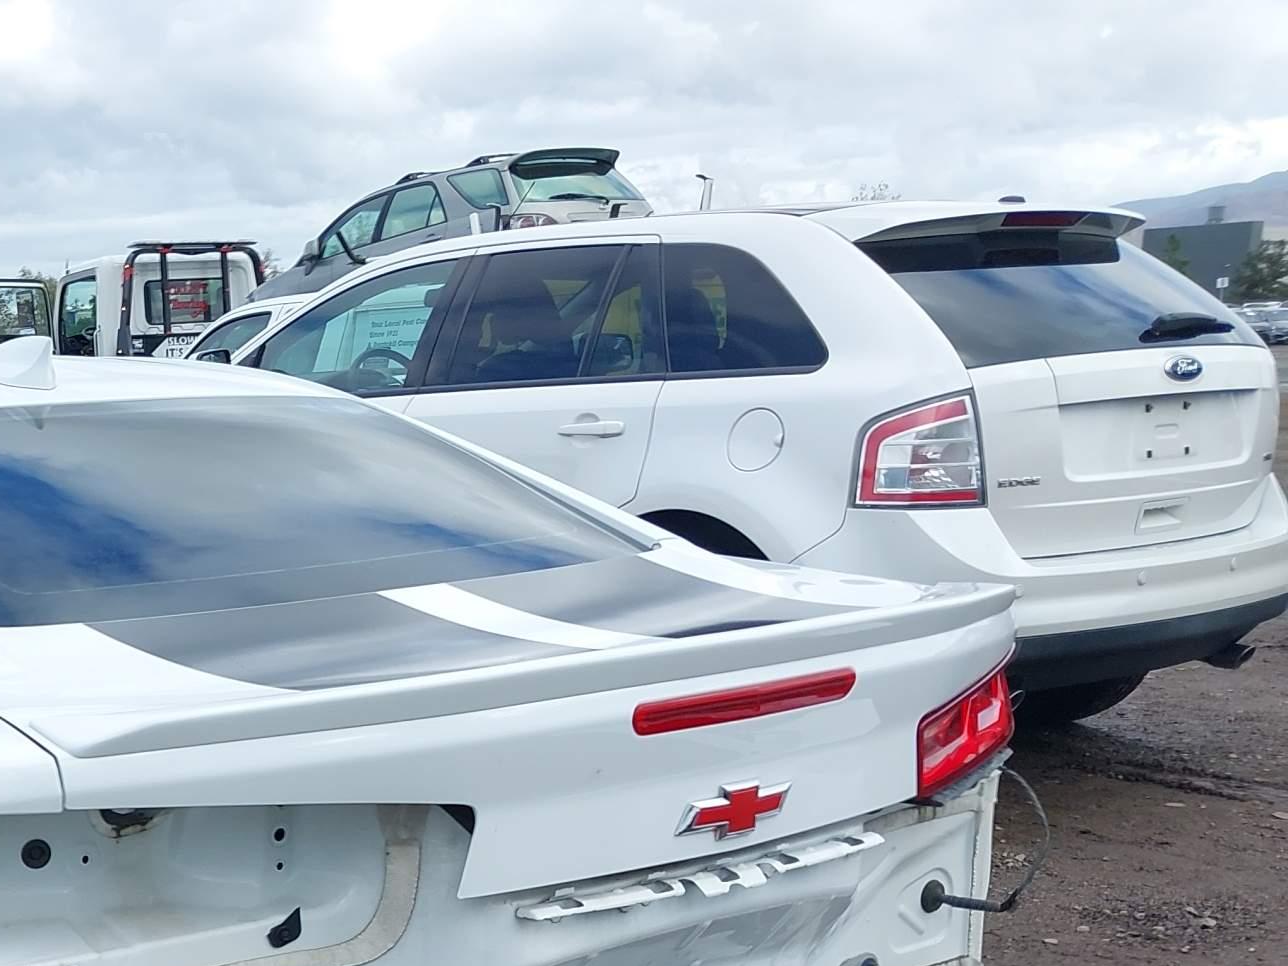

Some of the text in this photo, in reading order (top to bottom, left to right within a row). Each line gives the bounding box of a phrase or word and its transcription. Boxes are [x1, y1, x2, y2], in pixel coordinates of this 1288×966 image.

[384, 320, 401, 328] Local
[165, 348, 184, 358] IT'S
[1174, 359, 1192, 374] Ford
[997, 477, 1041, 489] EDGE
